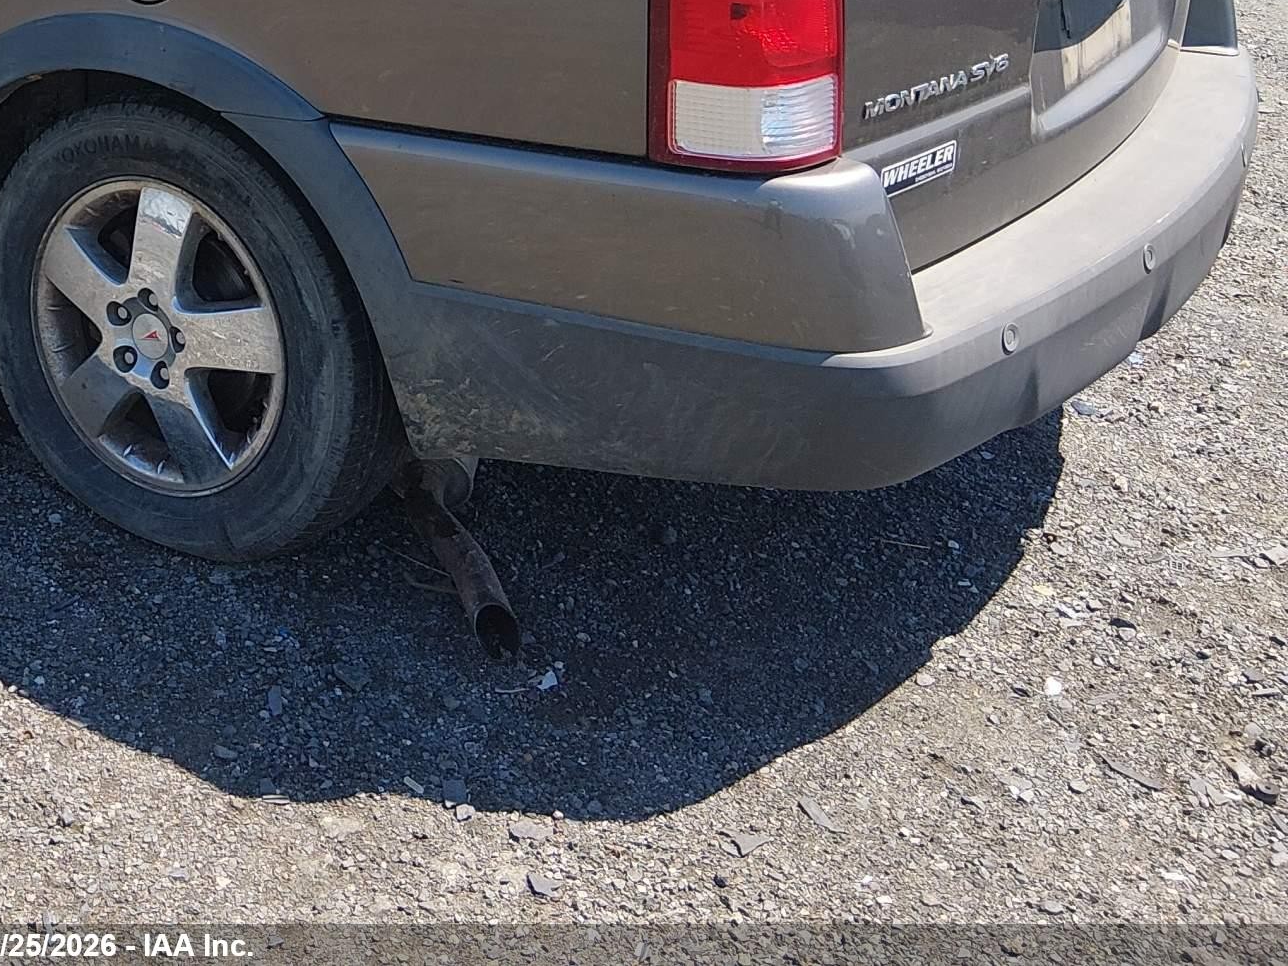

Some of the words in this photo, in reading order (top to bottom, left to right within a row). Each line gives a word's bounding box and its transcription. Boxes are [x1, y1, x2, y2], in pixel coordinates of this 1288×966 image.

[862, 70, 968, 120] MONTANA
[969, 52, 1010, 83] SV6
[883, 145, 954, 188] WHEELER
